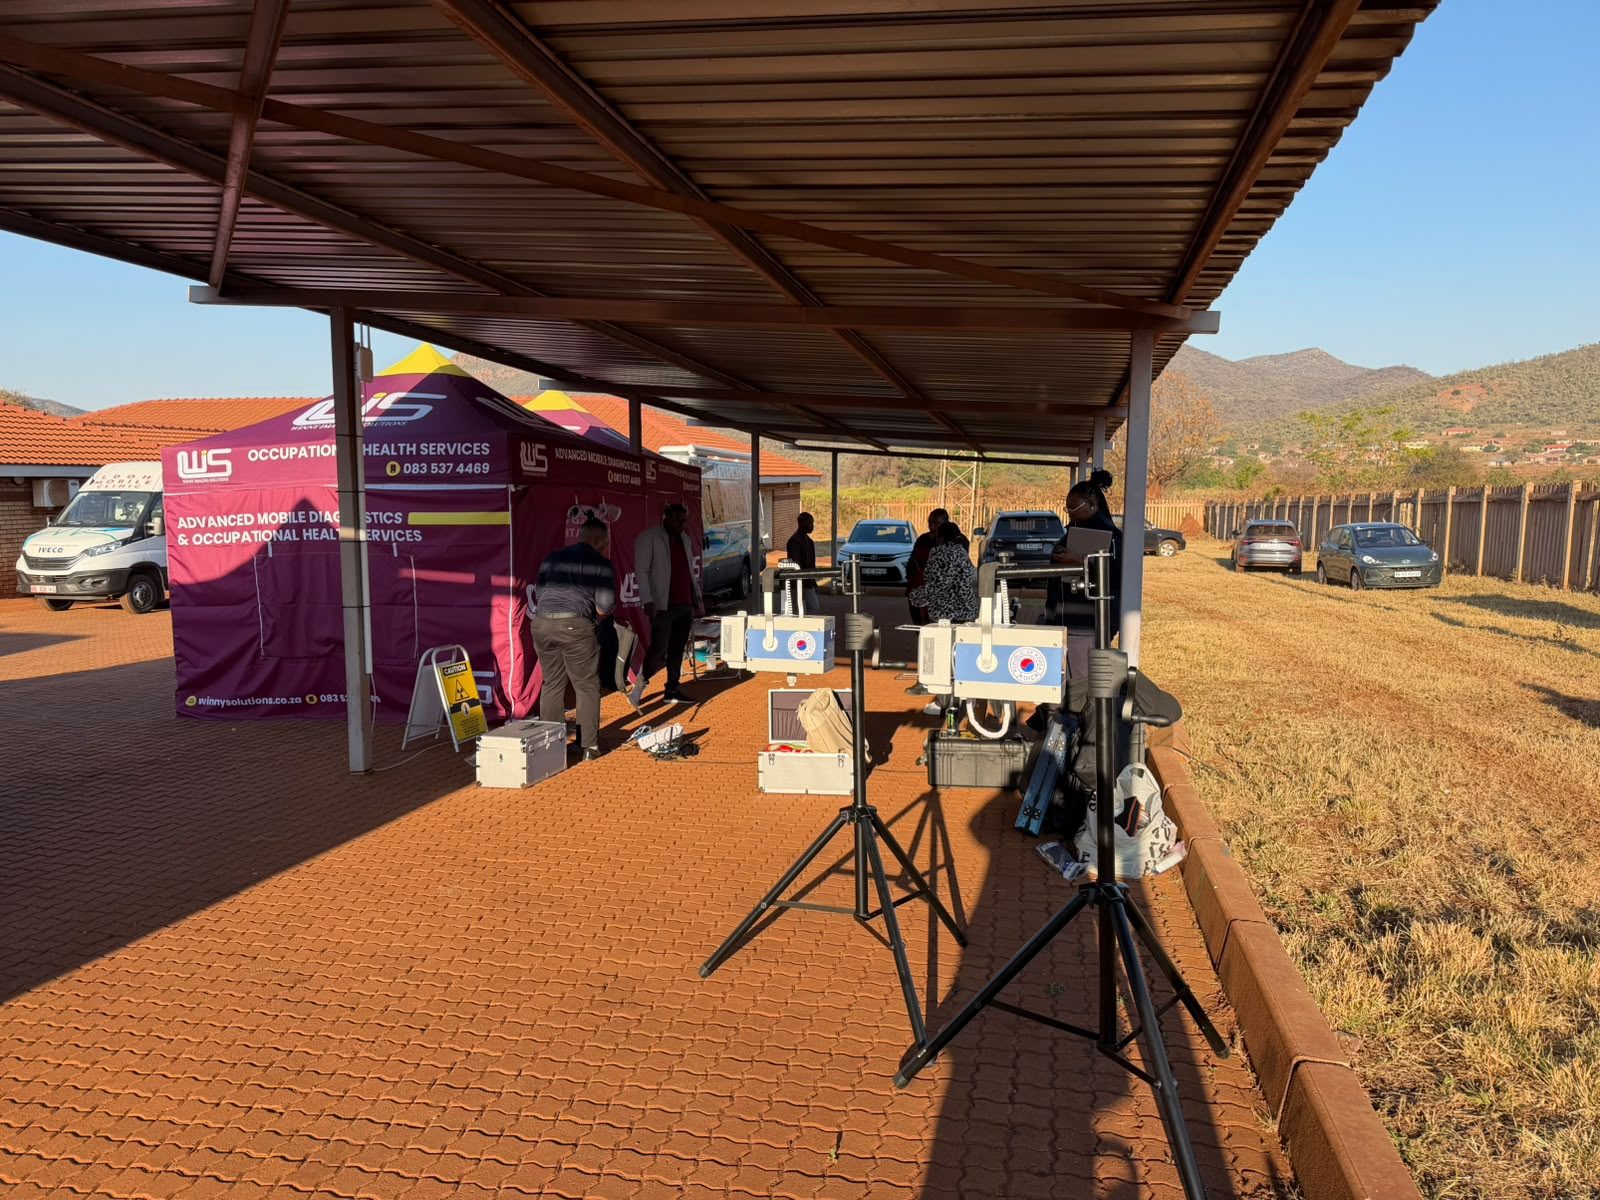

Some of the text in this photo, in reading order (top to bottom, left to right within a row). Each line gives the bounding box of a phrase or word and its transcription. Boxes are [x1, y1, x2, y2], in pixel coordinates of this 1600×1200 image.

[363, 443, 416, 456] HEALTH
[420, 443, 490, 455] SERVICES
[555, 448, 587, 460] ADVANCED
[403, 463, 490, 474] 083 537 4469
[177, 510, 403, 529] ADVANCED MOBILE DIAGSTICS
[177, 534, 189, 546] &
[192, 529, 299, 545] OCCUPATIONAL
[366, 528, 422, 542] ERVICES
[444, 664, 466, 675] CAUTION
[198, 695, 302, 708] winnysolutions.co.za
[320, 694, 338, 703] 083
